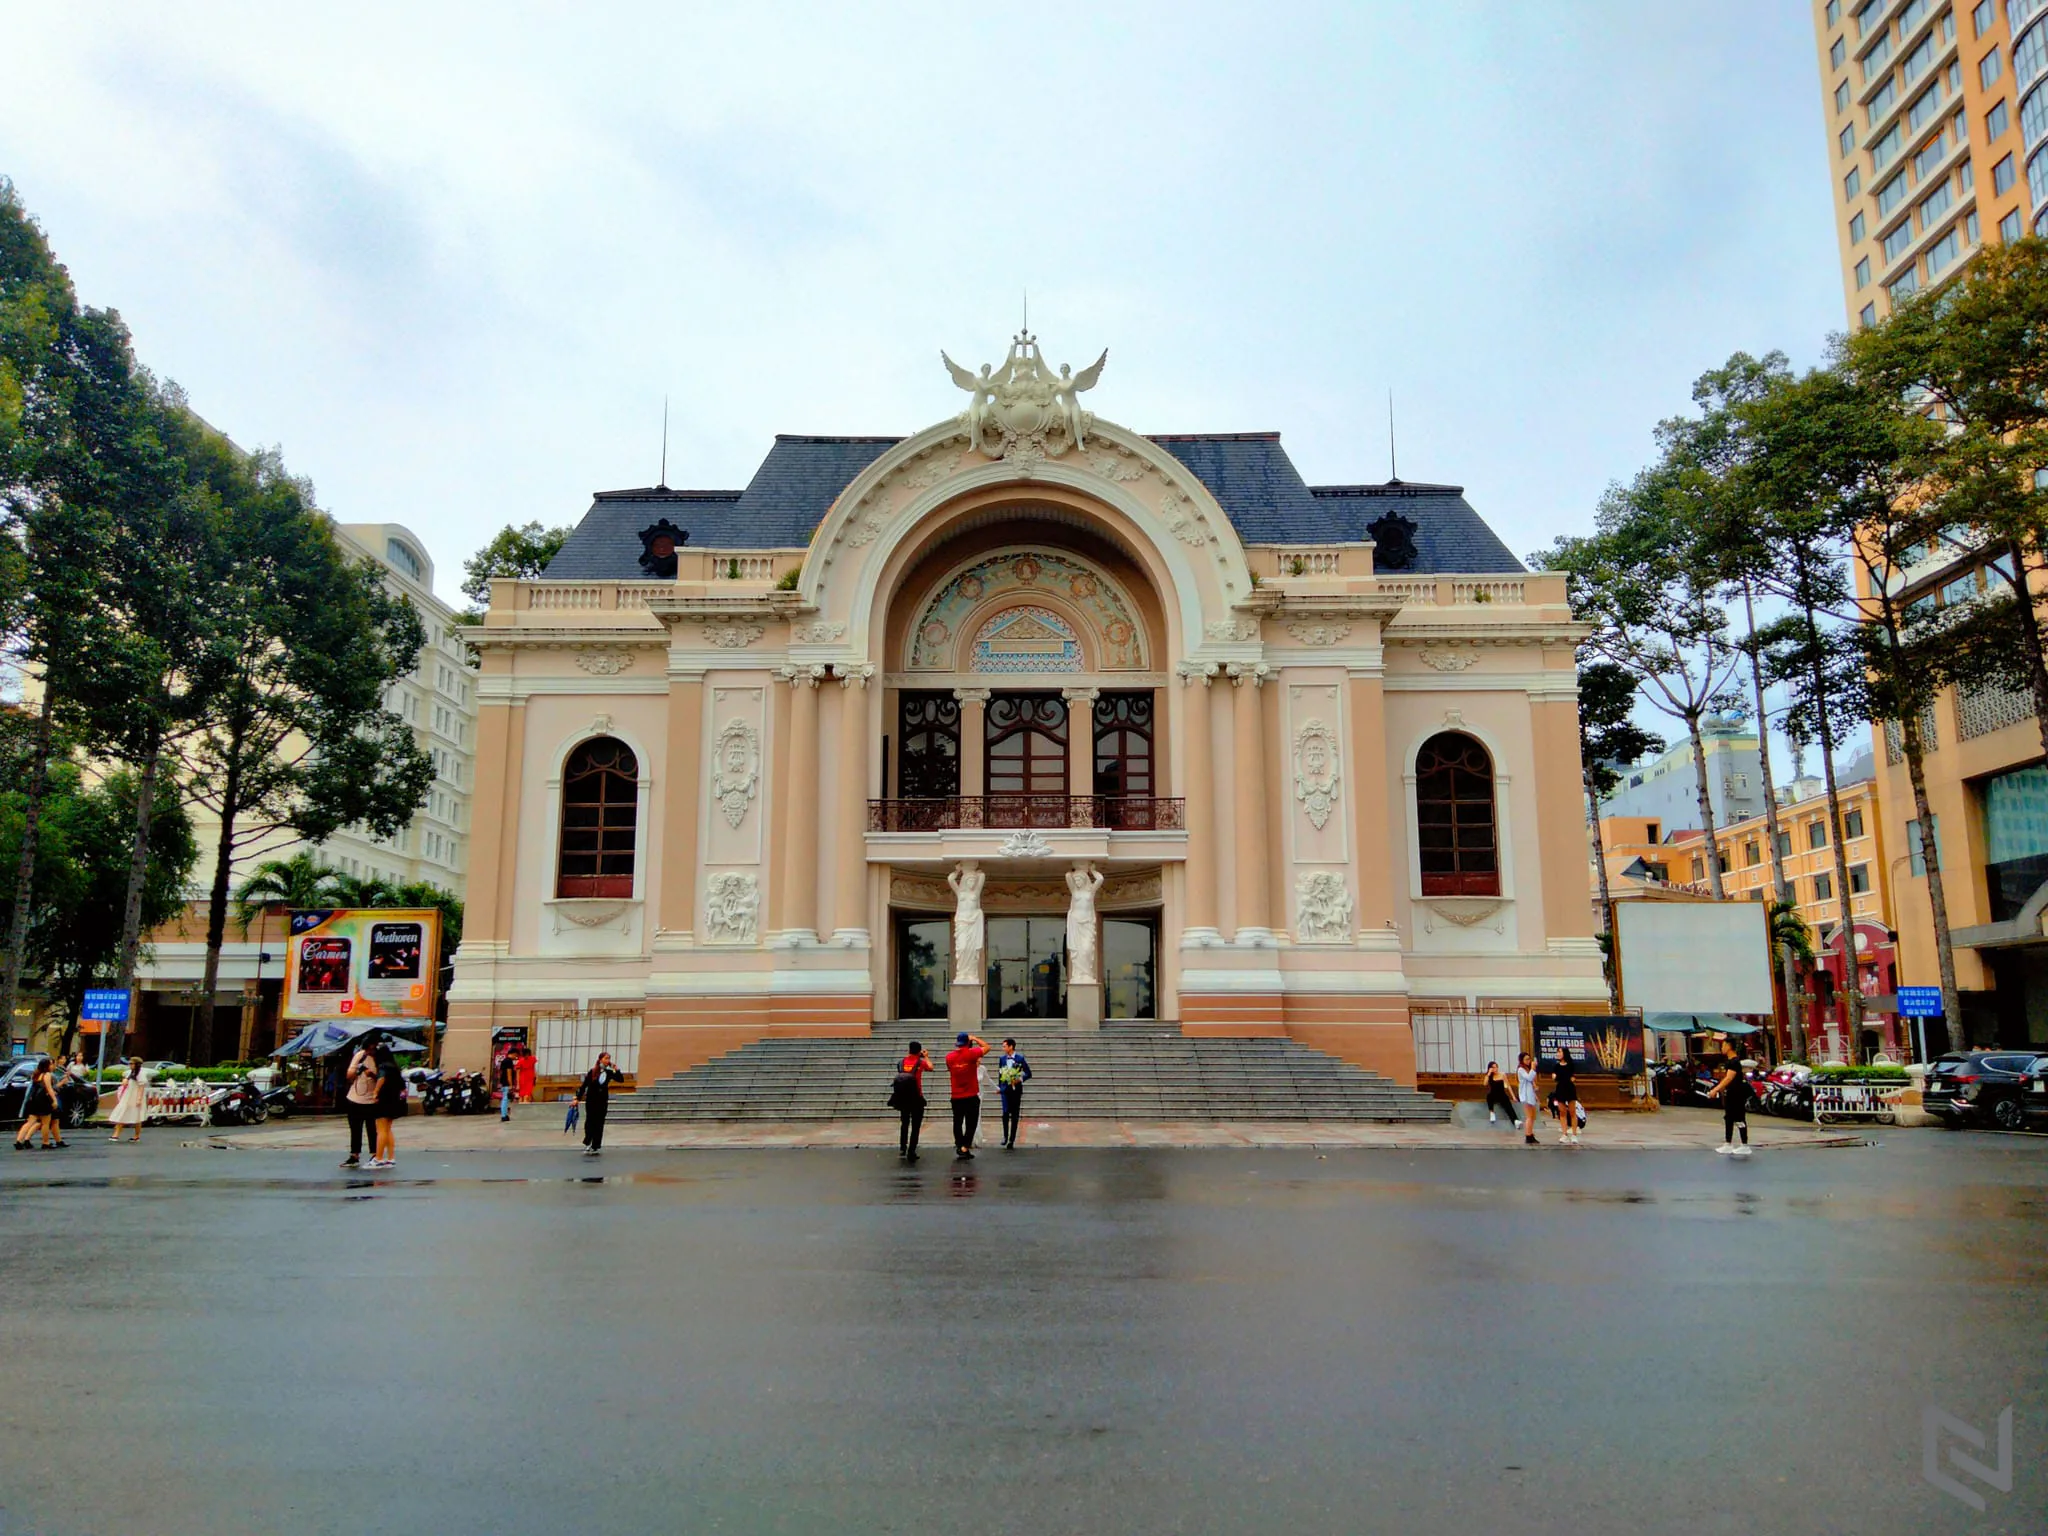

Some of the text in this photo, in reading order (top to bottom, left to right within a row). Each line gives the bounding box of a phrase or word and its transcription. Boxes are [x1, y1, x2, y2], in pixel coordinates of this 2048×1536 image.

[375, 930, 418, 943] Beethoven
[303, 942, 348, 960] Carmen
[1540, 1039, 1585, 1047] GET INSIDE
